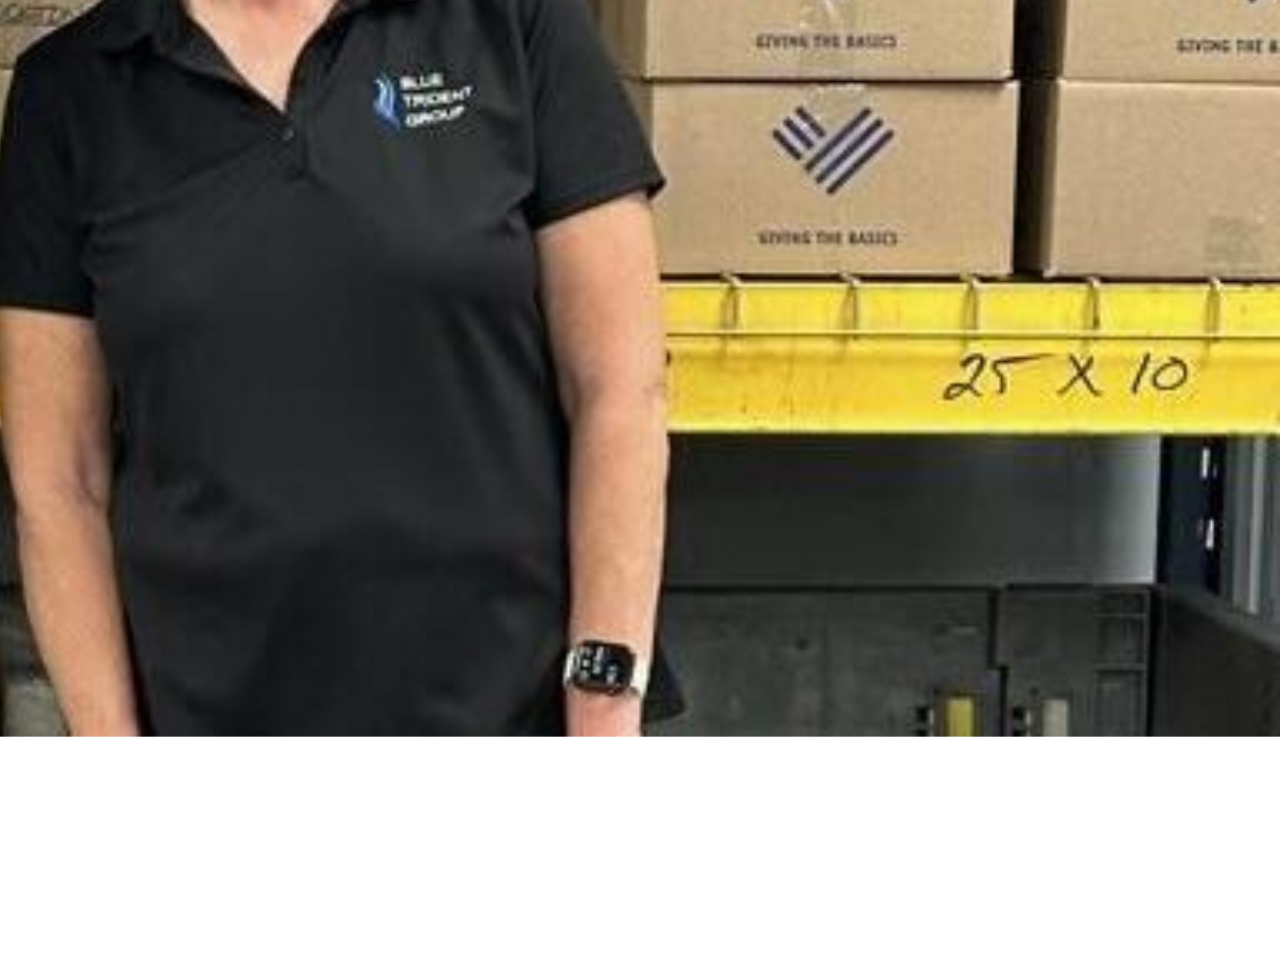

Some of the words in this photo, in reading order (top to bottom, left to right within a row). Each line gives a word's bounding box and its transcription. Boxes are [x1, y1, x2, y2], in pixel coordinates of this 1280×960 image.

[756, 34, 807, 49] GIVING
[813, 34, 840, 49] THE
[846, 35, 897, 49] BASICS
[399, 73, 444, 91] BLUE
[401, 85, 473, 108] TRIDENT
[404, 104, 466, 128] GROUP
[759, 231, 810, 245] GIVING
[815, 231, 841, 245] THE
[848, 232, 898, 246] BASICS
[942, 352, 1056, 401] 25
[1056, 353, 1102, 398] X
[1130, 351, 1188, 395] 10
